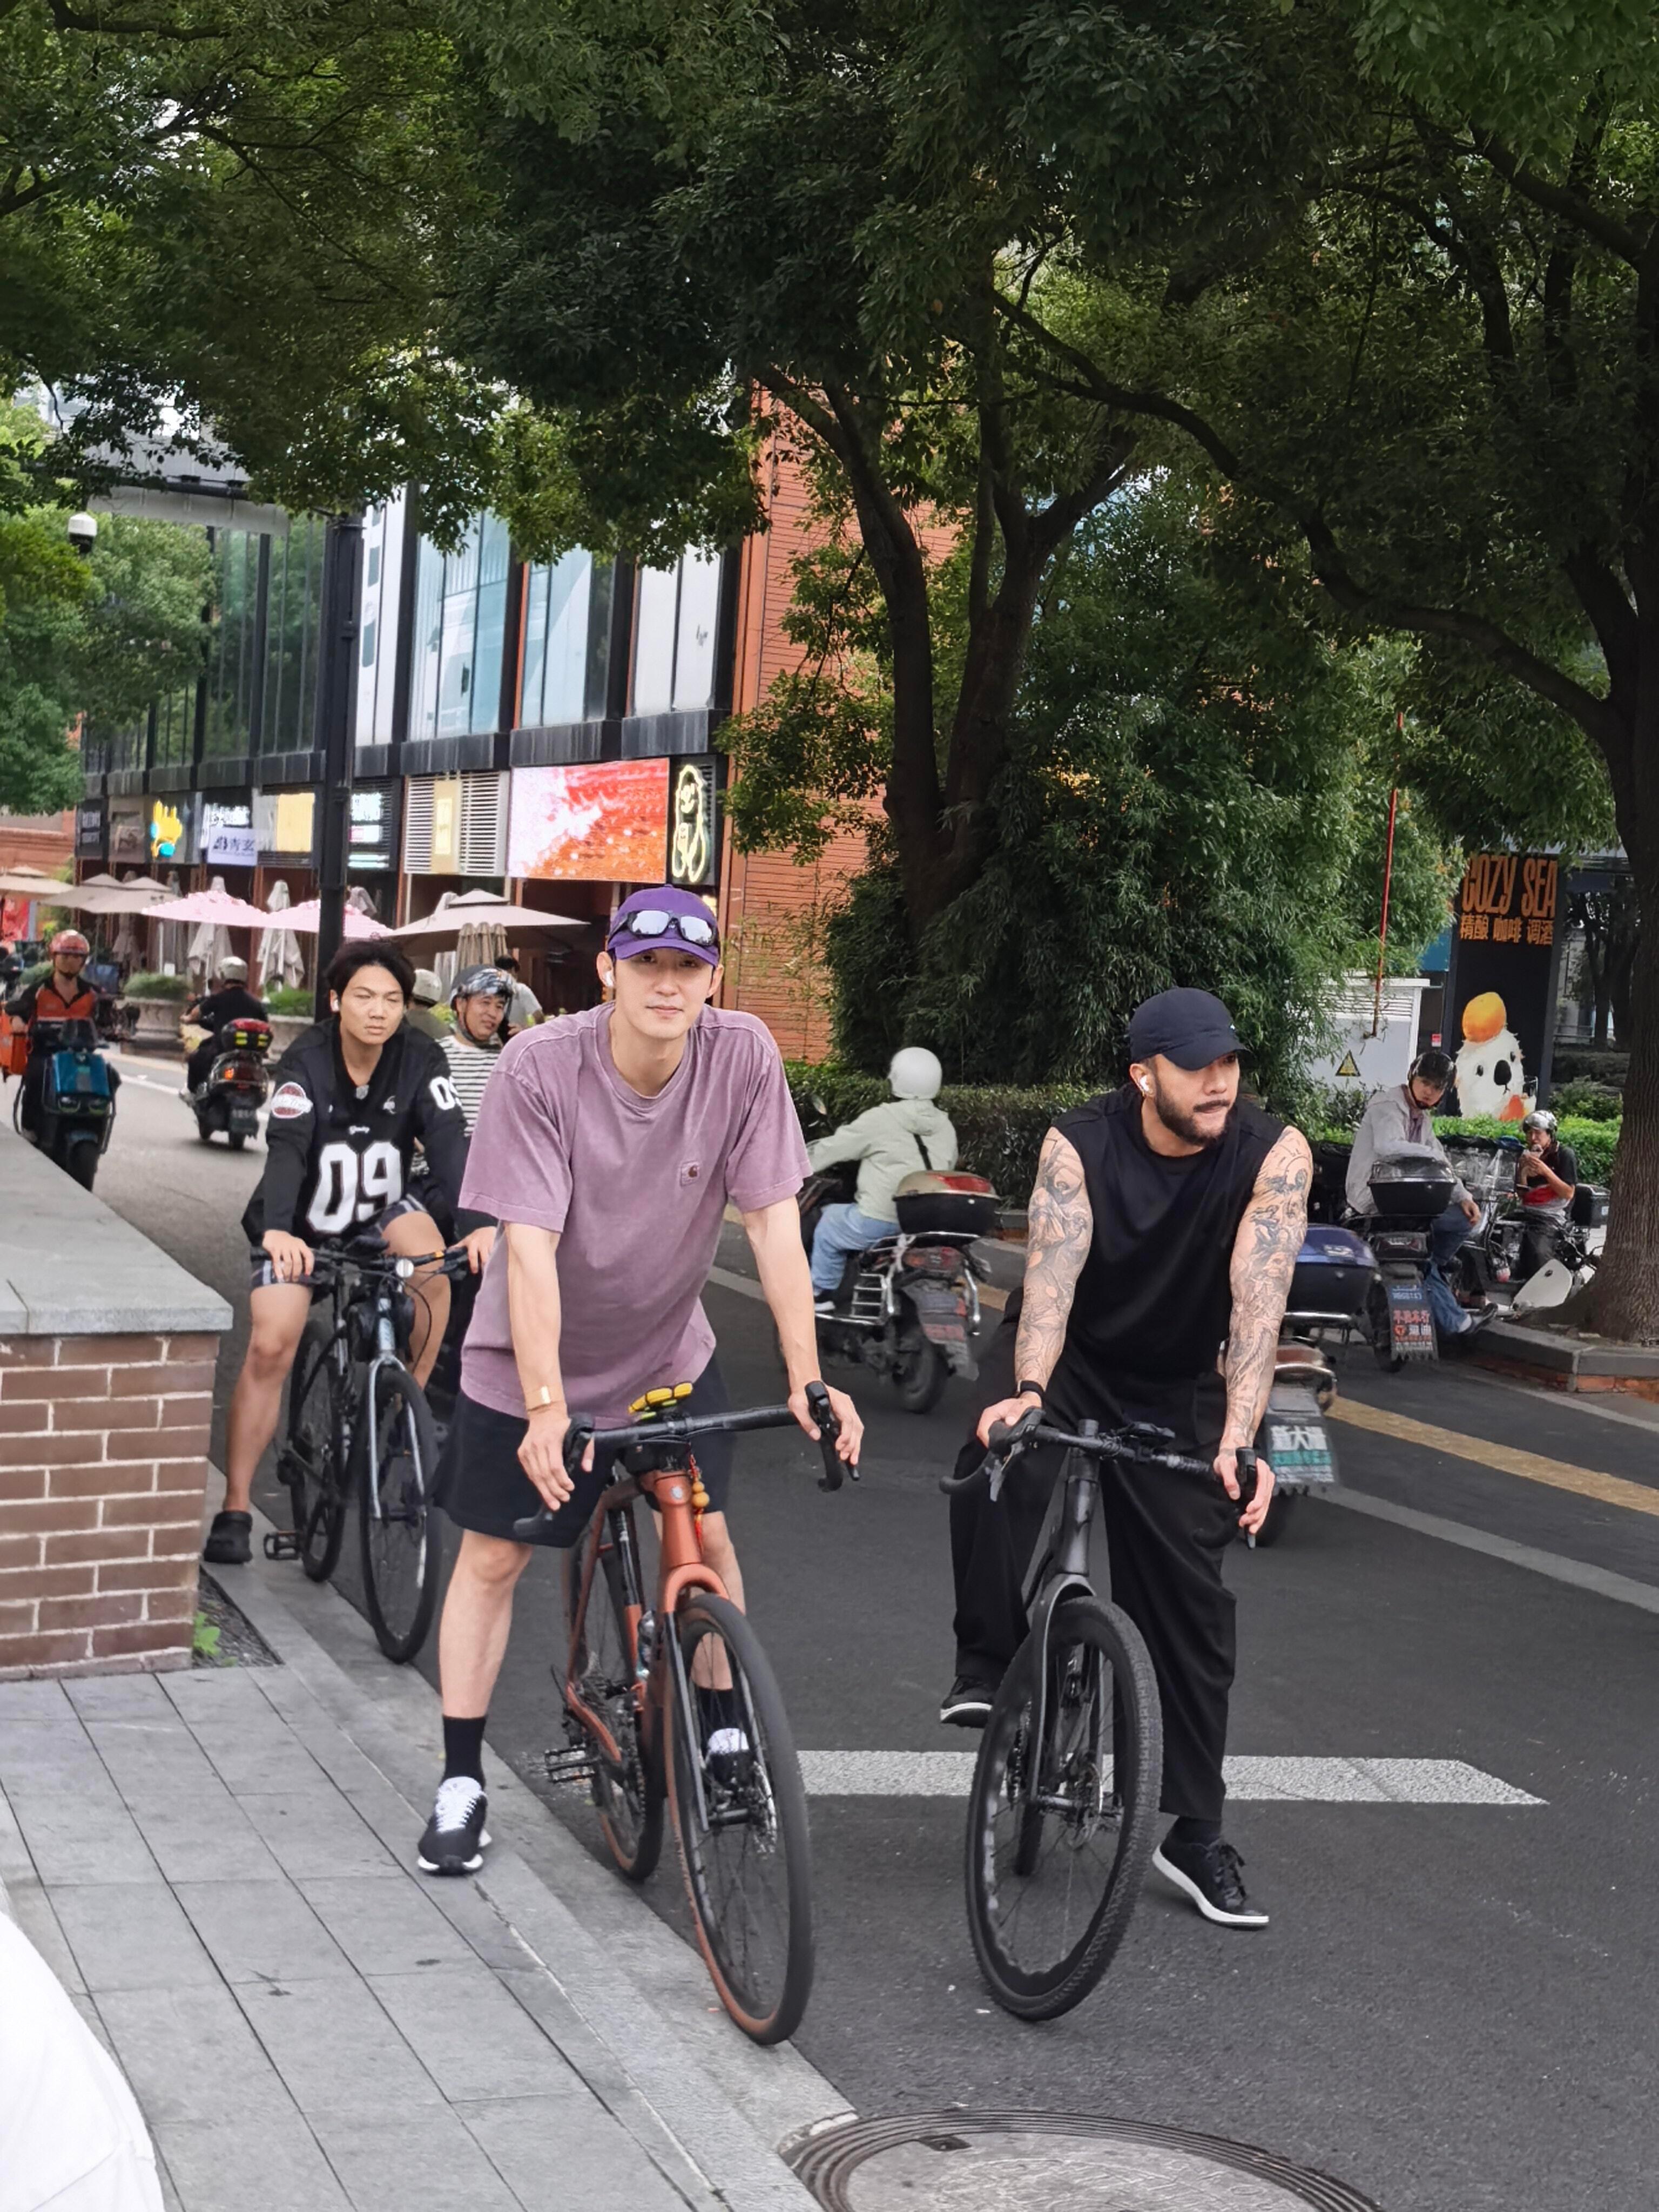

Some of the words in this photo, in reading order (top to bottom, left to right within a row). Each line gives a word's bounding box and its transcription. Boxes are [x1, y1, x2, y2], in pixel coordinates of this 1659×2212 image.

[1462, 853, 1518, 915] COZY
[1521, 858, 1558, 918] SEA
[1460, 913, 1488, 940] 精酿
[1493, 916, 1522, 943] 咖啡
[1526, 919, 1554, 945] 调酒
[306, 1141, 403, 1233] 09
